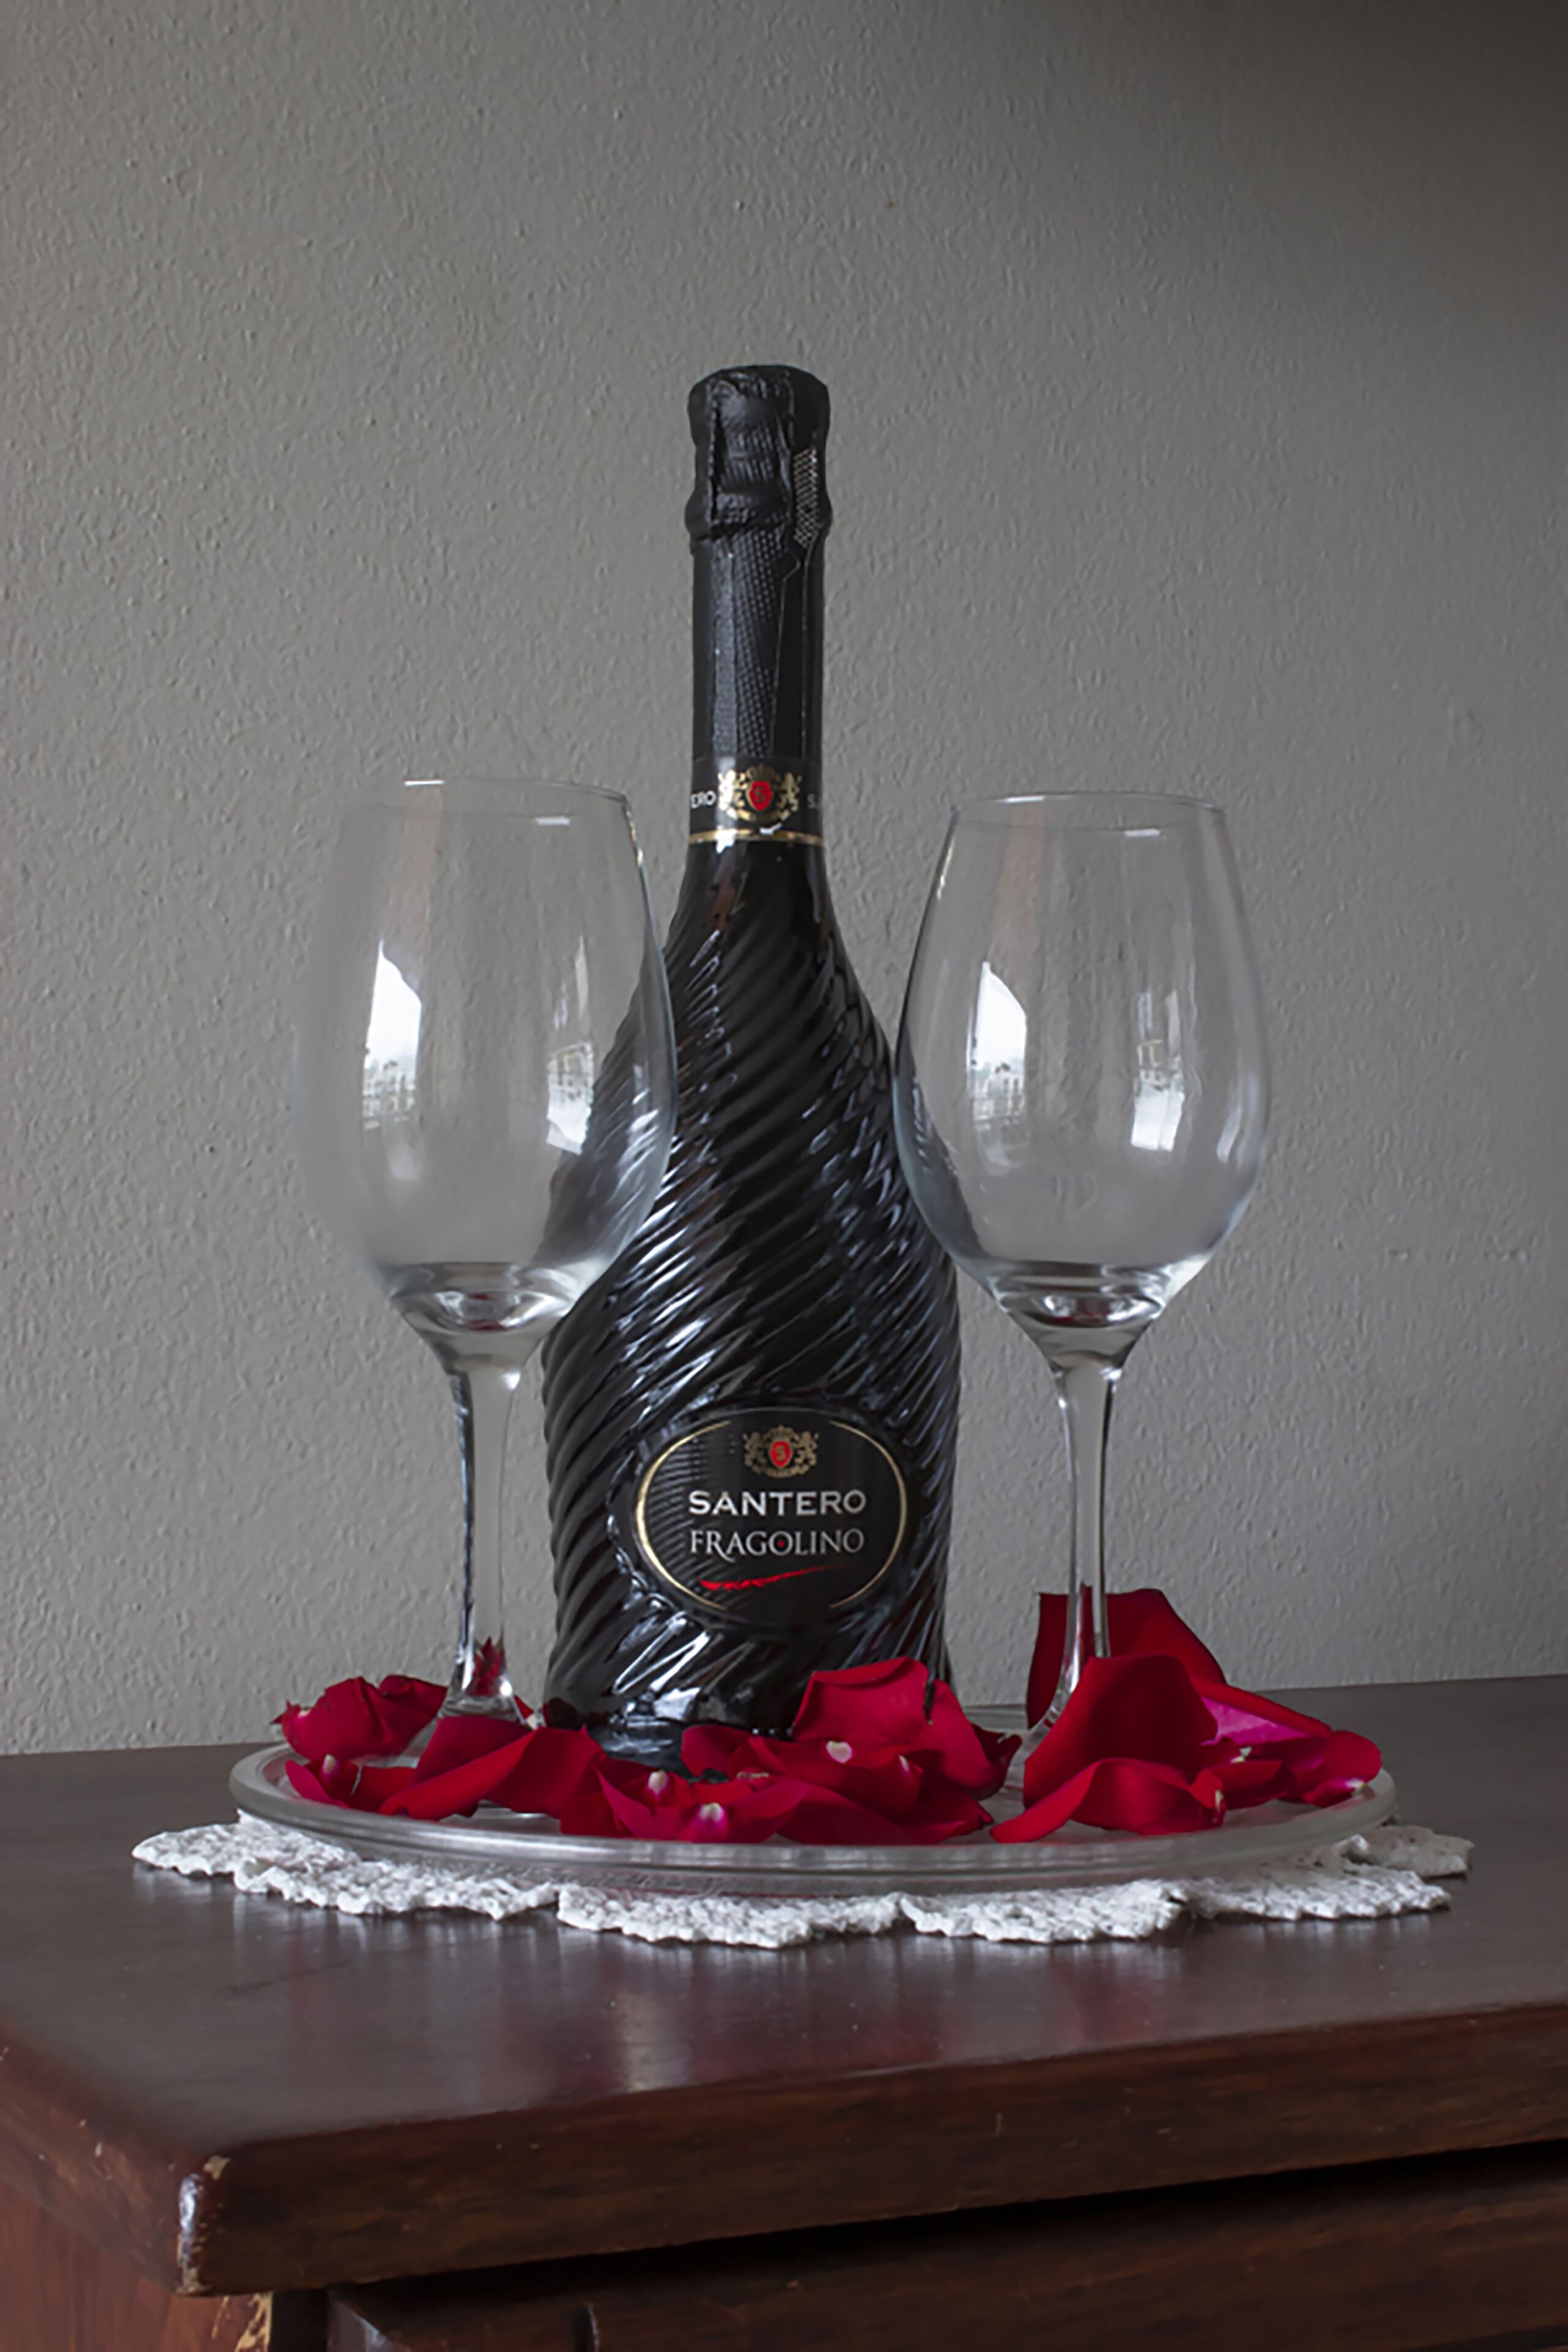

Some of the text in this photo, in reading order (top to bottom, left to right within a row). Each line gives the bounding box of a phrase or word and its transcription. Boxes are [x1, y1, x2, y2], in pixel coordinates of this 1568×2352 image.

[755, 786, 766, 803] S
[775, 1446, 786, 1461] S
[688, 1490, 866, 1516] SANTERO
[690, 1528, 864, 1562] FRAGOLINO
